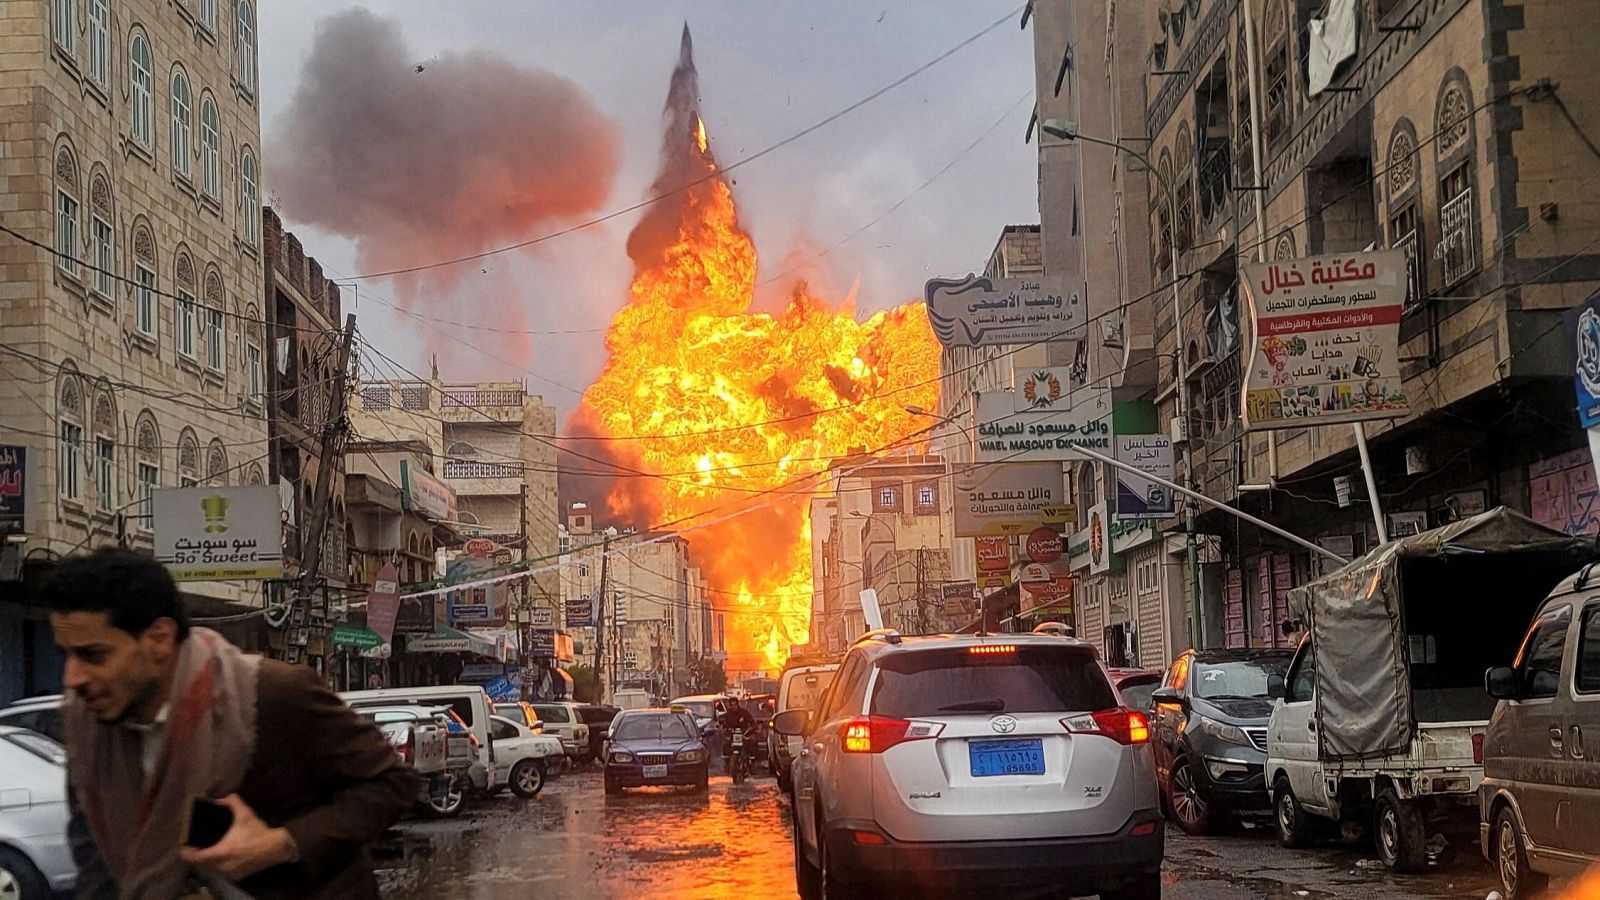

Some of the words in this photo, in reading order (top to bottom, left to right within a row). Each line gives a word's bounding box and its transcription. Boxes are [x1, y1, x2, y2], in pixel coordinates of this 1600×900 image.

[1261, 263, 1305, 295] خيال
[1311, 258, 1375, 290] مكتبة
[1020, 281, 1040, 292] عيادة
[1025, 294, 1062, 310] وهيب
[1266, 297, 1295, 313] التجميل
[1298, 294, 1346, 309] ومستحضرات
[1349, 290, 1376, 305] للعطور
[979, 421, 1024, 438] للصرافة
[1028, 423, 1076, 436] مسعود
[1080, 420, 1108, 435] وائل
[979, 440, 1007, 451] WAEL
[1009, 439, 1053, 450] MASOUD
[1055, 437, 1109, 449] EXCHANGE
[1124, 437, 1169, 450] مغاسل
[1133, 449, 1159, 461] الخير
[969, 489, 1025, 502] مسعود
[175, 538, 227, 554] سويت
[232, 539, 257, 553] سو
[175, 552, 196, 564] So
[202, 551, 258, 564] Sweet
